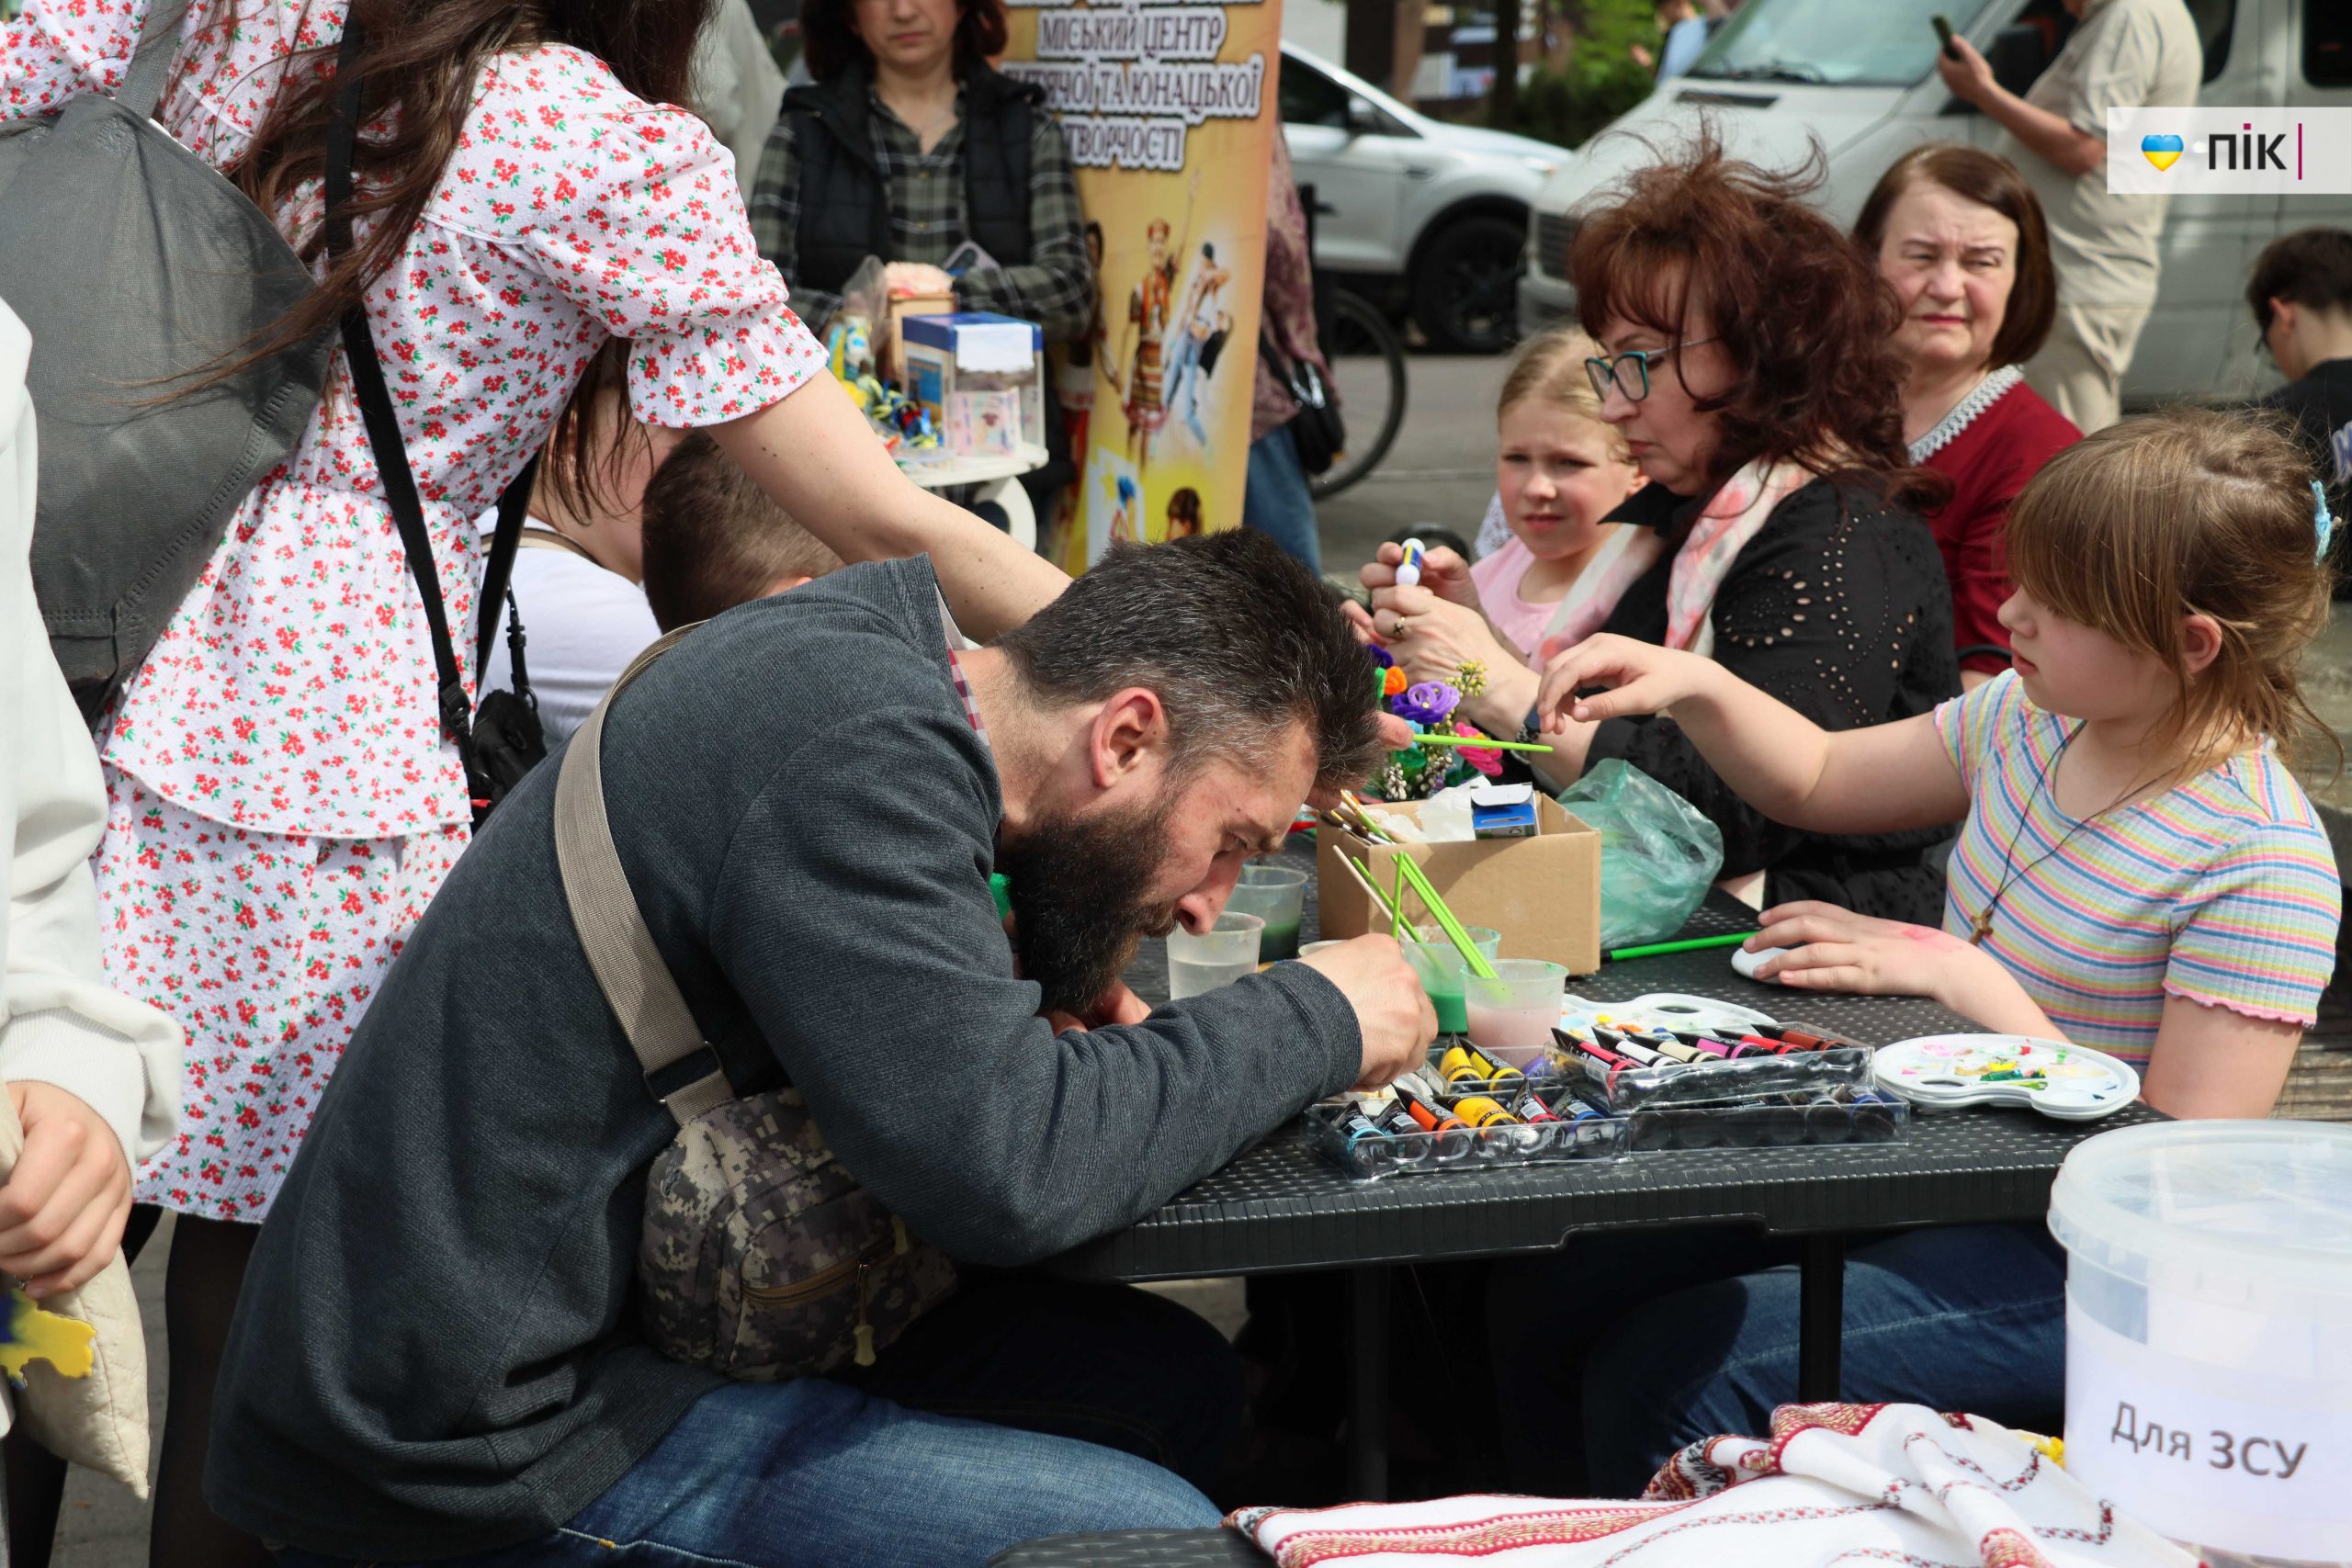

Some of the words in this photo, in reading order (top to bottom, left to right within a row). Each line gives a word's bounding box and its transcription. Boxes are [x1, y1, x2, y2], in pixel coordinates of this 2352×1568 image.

[1041, 7, 1137, 51] МІСЬКИЙ
[1143, 15, 1223, 58] ЦЕНТР
[1004, 63, 1094, 106] ЯЧОЇ
[1100, 70, 1125, 106] ТА
[1131, 64, 1260, 114] ЮНАЦЬКОЇ
[1064, 122, 1181, 162] ТВОРЧОСТІ
[2110, 1400, 2192, 1462] Для
[2208, 1428, 2309, 1480] ЗСУ
